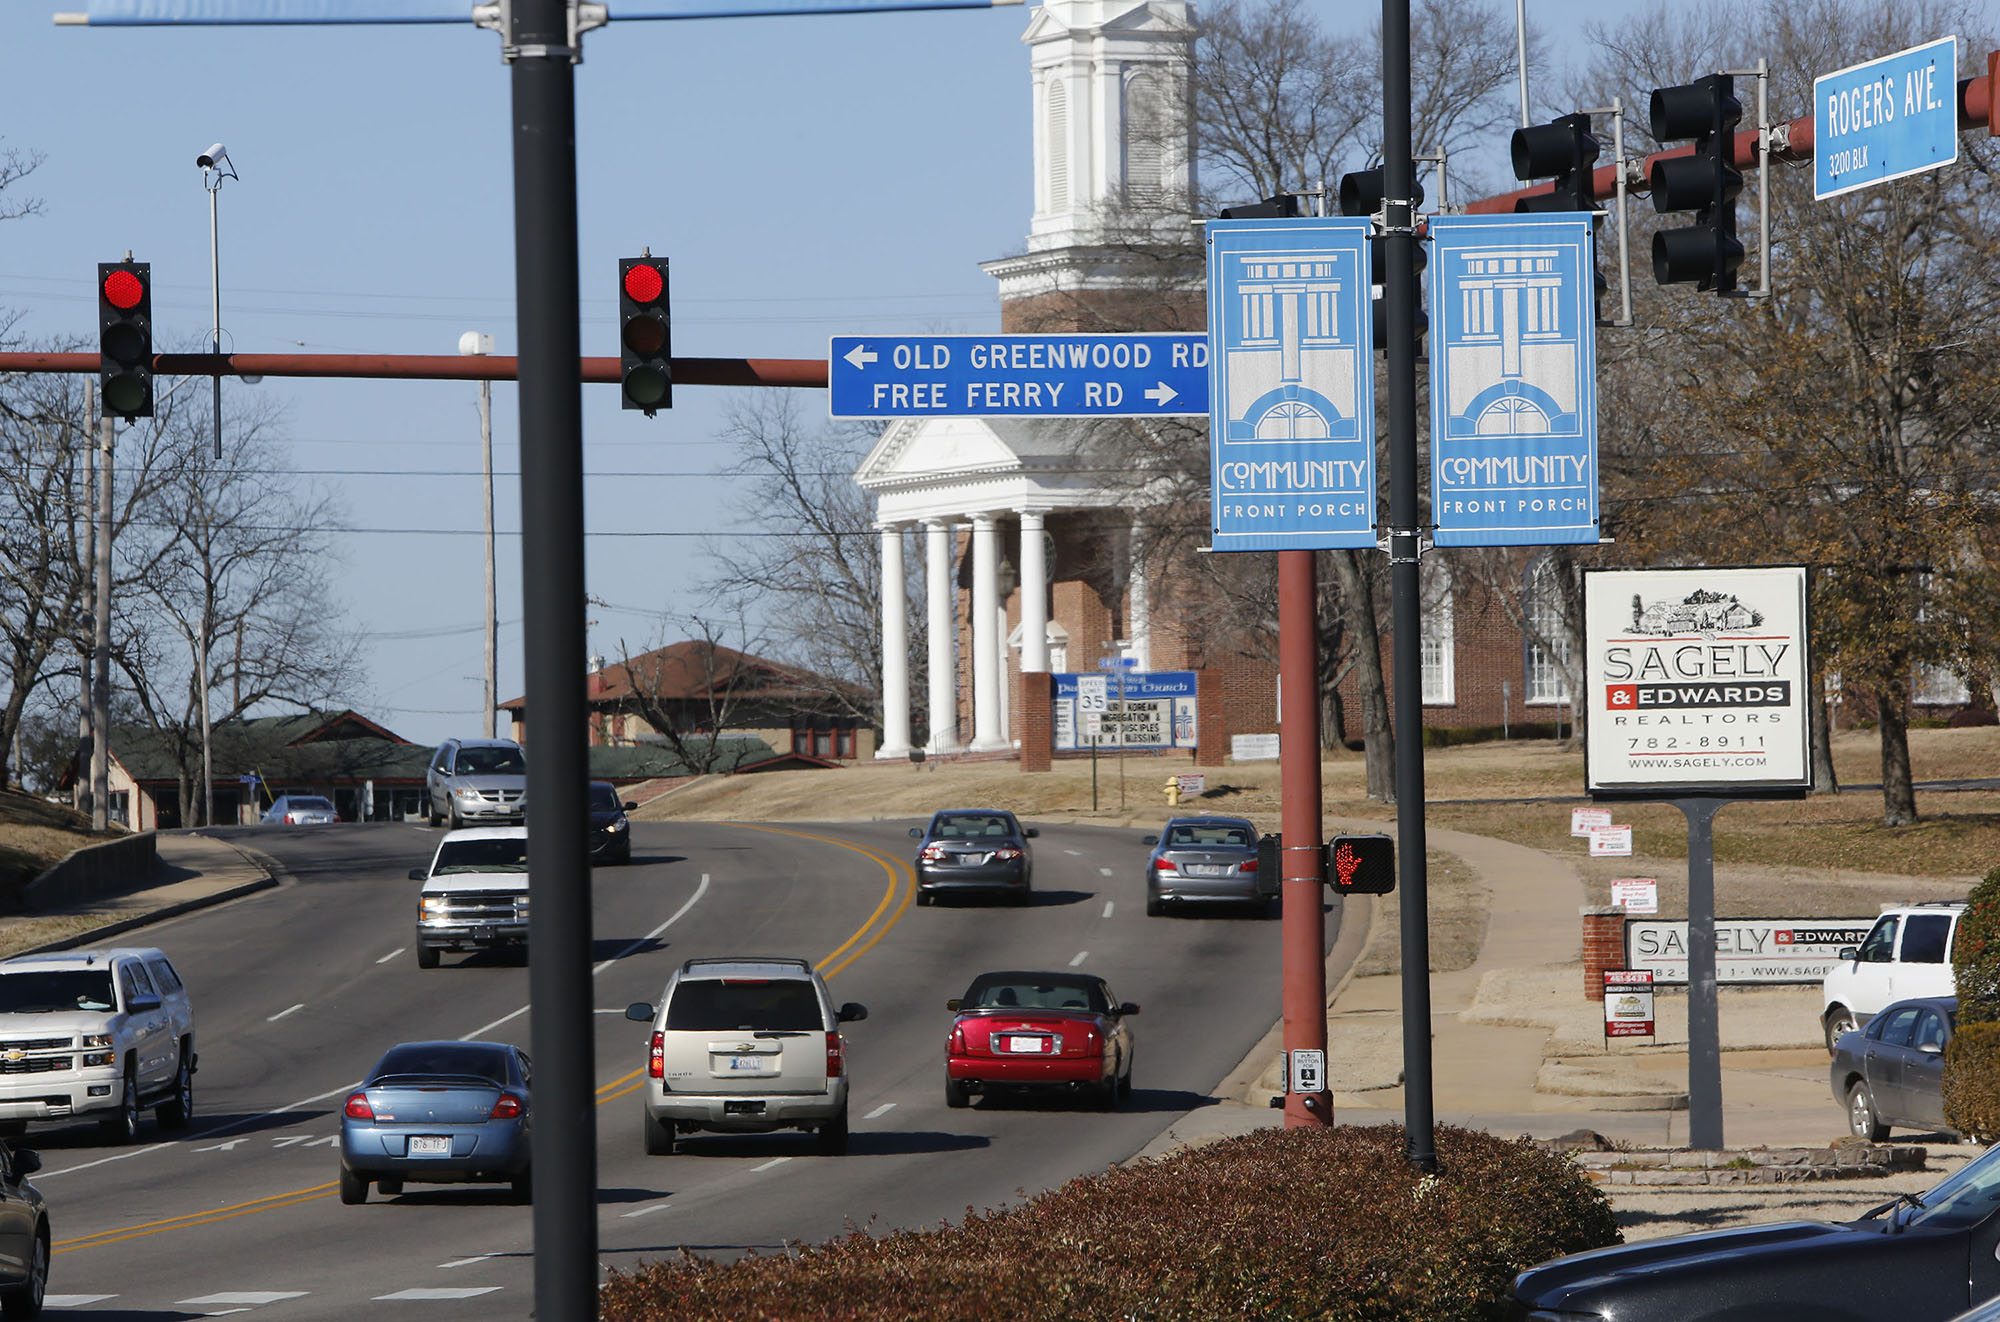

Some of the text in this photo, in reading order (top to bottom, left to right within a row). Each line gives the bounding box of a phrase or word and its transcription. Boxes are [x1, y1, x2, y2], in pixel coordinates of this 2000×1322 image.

[1828, 65, 1942, 138] ROGERS AVE.
[1829, 144, 1869, 177] 3200 BLK
[893, 343, 1209, 370] OLD GREENWOOD RD
[873, 382, 1124, 409] FREE FERRY RD
[1221, 460, 1366, 489] COMMUNITY
[1440, 455, 1588, 485] COMMUNITY
[1223, 503, 1366, 518] FRONT PORCH
[1443, 498, 1587, 514] FRONT PORCH
[1603, 644, 1789, 681] SAGELY
[1081, 695, 1105, 709] 35
[1611, 686, 1784, 705] & EDWARDS
[1128, 703, 1158, 711] KOREAN
[1101, 713, 1150, 722] NGREGATION
[1615, 713, 1781, 725] REALTORS
[1101, 724, 1118, 733] UNG
[1125, 734, 1162, 743] BLESSING
[1628, 736, 1764, 749] 782-8911
[1629, 757, 1767, 769] WWW.SAGELY.COM
[1638, 929, 1867, 956] SAELY & EDWARD
[1655, 968, 1735, 977] 82-11
[1752, 966, 1834, 976] WWW.SAGE
[413, 1140, 428, 1149] 876
